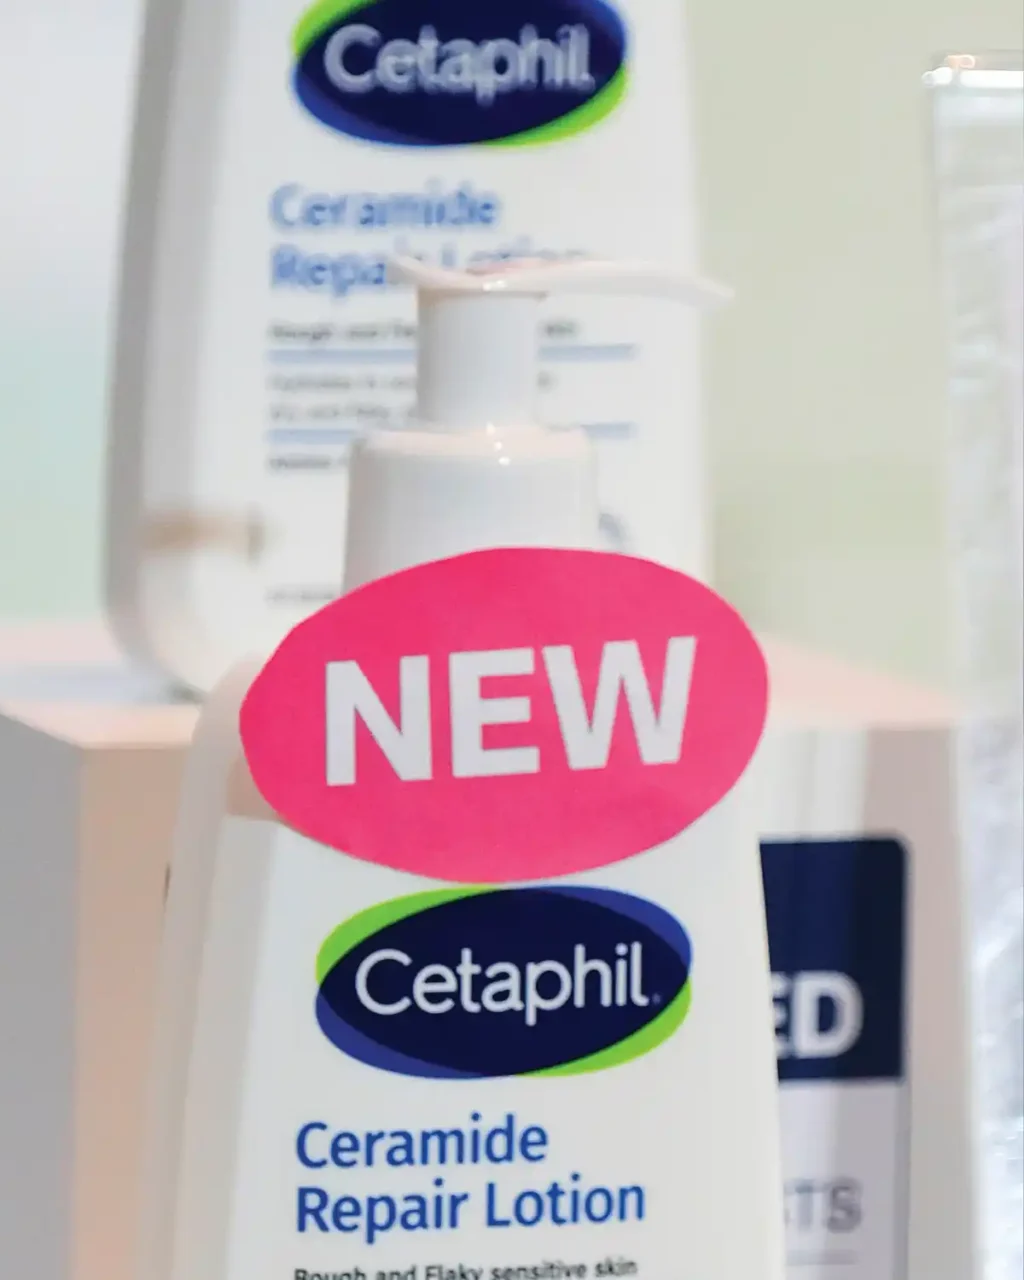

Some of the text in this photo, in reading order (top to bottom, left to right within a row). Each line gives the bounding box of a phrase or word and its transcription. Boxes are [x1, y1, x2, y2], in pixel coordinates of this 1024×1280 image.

[323, 24, 593, 104] Cetaphil
[269, 178, 500, 228] Ceramide
[326, 636, 697, 786] NEW
[354, 941, 650, 1027] Cetaphil
[296, 1113, 547, 1168] Ceramide
[297, 1173, 644, 1244] Repair Lotion
[595, 1257, 637, 1277] skin
